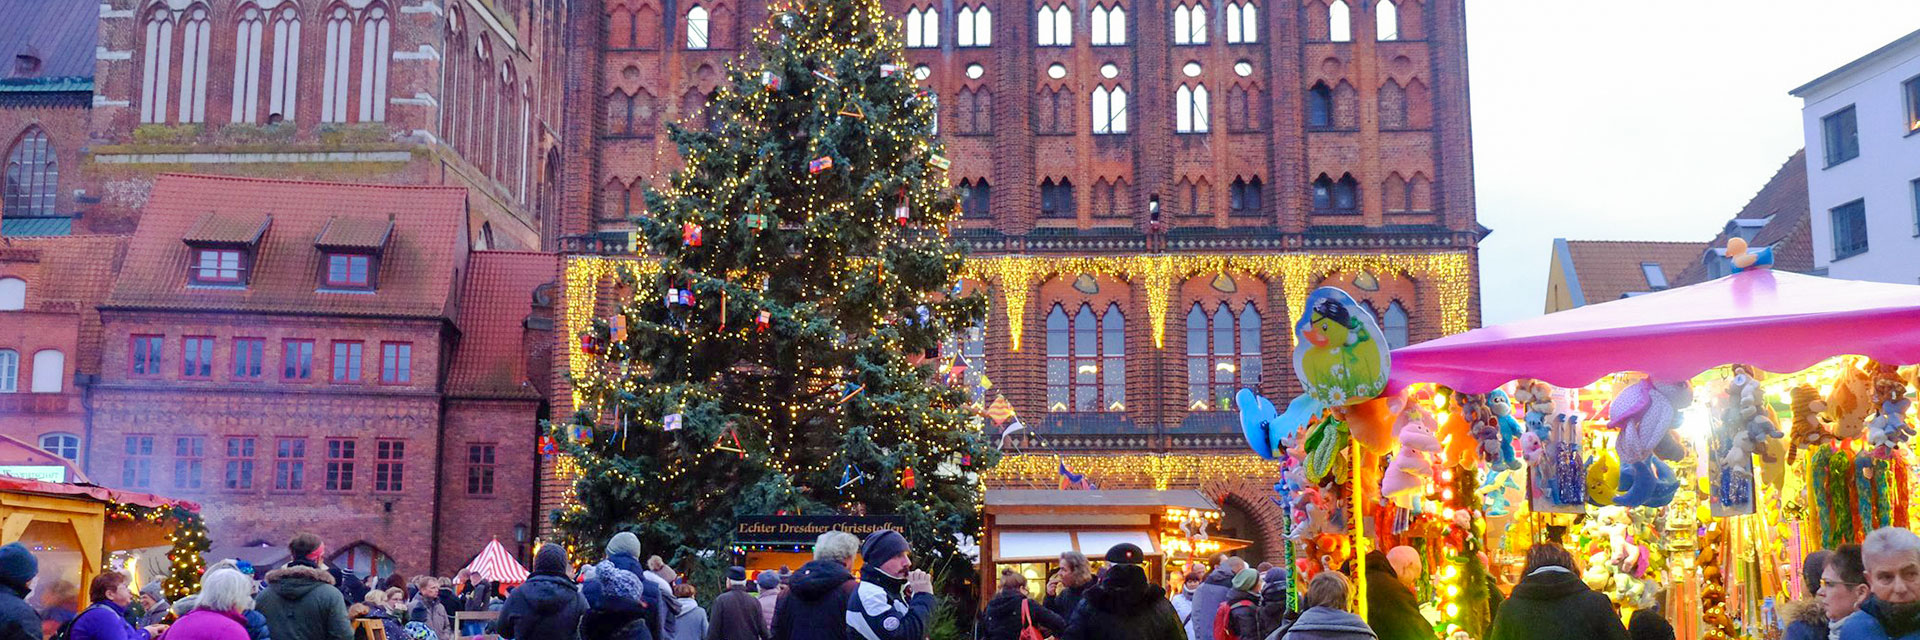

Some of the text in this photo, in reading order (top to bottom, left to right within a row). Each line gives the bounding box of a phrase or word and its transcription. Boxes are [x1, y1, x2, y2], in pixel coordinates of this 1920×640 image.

[739, 521, 904, 533] Echter Dresdner Christstollen
